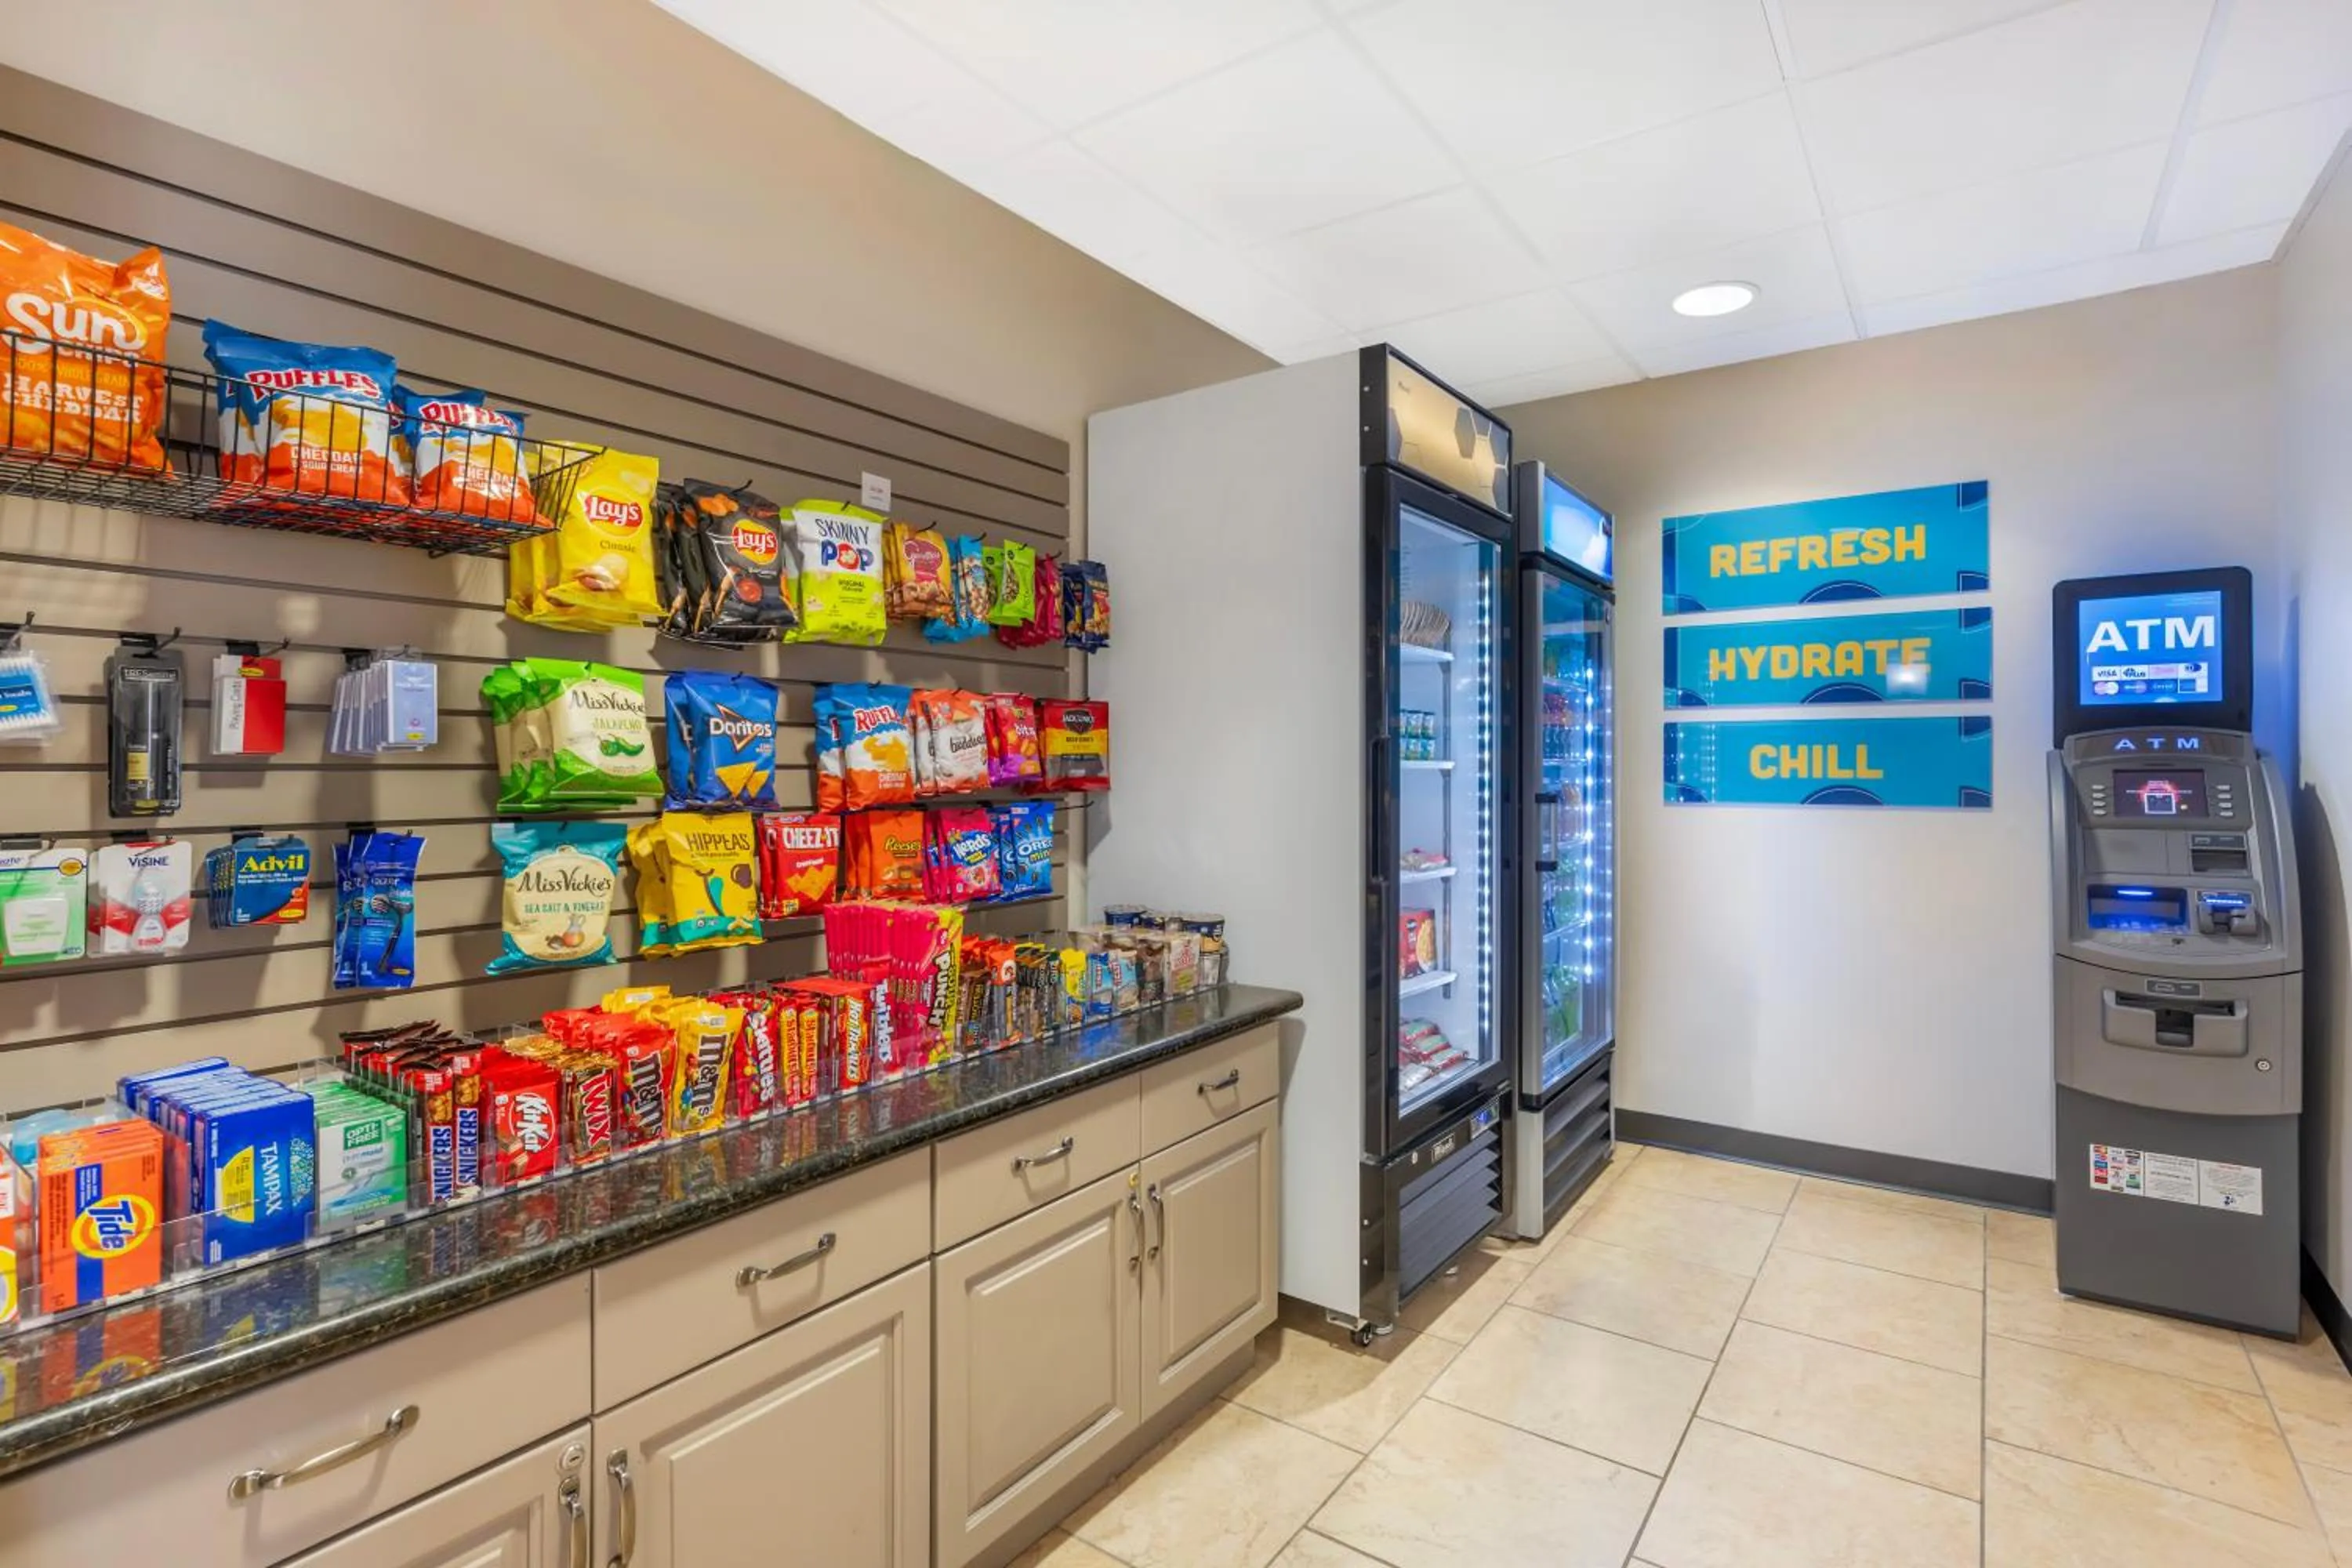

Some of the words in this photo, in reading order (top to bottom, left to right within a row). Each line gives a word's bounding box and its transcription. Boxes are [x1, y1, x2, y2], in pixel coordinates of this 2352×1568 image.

[2, 292, 147, 354] Sun
[3, 372, 143, 408] HARVEST
[245, 368, 379, 402] RUFFLES
[2, 391, 142, 424] CHEDDAR
[589, 495, 639, 528] Lay's
[815, 518, 870, 545] SKINNY
[820, 539, 874, 572] POP
[1709, 524, 1926, 579] REFRESH
[2085, 615, 2216, 653] ATM
[1708, 637, 1932, 681] HYDRATE
[710, 717, 773, 738] Doritos
[2114, 737, 2199, 750] ATM
[1749, 743, 1884, 780] CHILL
[685, 833, 750, 852] HIPPEAS
[239, 854, 305, 873] Advil
[557, 866, 612, 898] Vickie's
[927, 951, 951, 1027] PUNCH
[579, 1072, 612, 1148] TWIX
[458, 1109, 478, 1185] SNICKERS
[260, 1141, 284, 1217] TAMPAX
[88, 1198, 136, 1250] Tide
